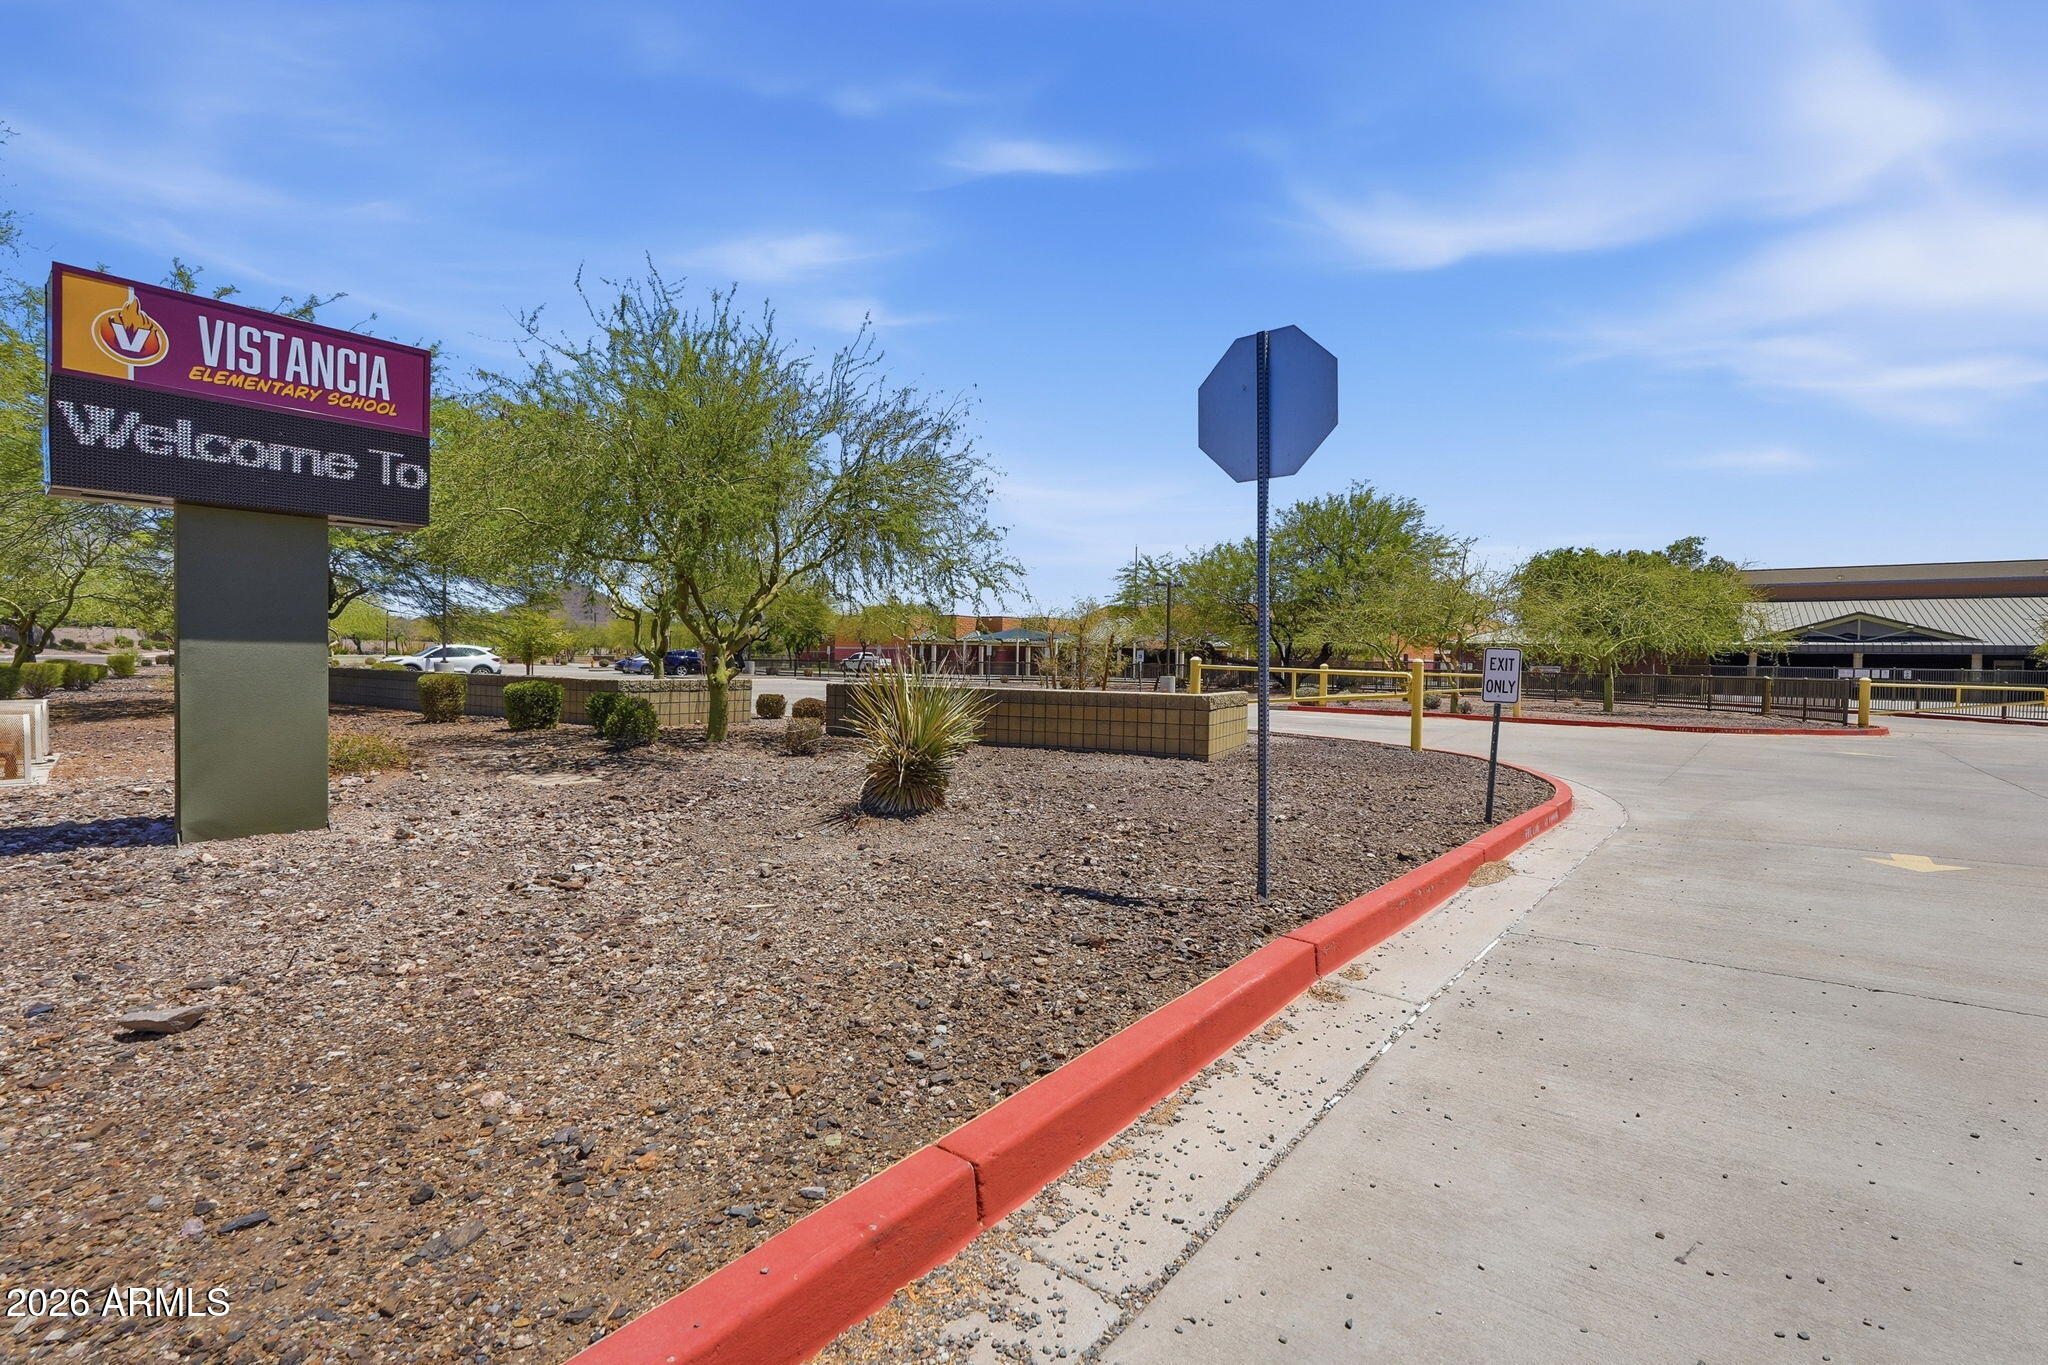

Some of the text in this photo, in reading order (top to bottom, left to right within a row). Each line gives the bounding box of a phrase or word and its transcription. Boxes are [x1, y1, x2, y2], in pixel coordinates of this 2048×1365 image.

[111, 322, 151, 353] V
[198, 315, 390, 401] VISTANCIA
[188, 366, 398, 417] ELEMENTARY SCHOOL
[56, 400, 428, 490] Welcome To
[1490, 657, 1515, 671] EXIT
[1486, 679, 1516, 694] ONLY
